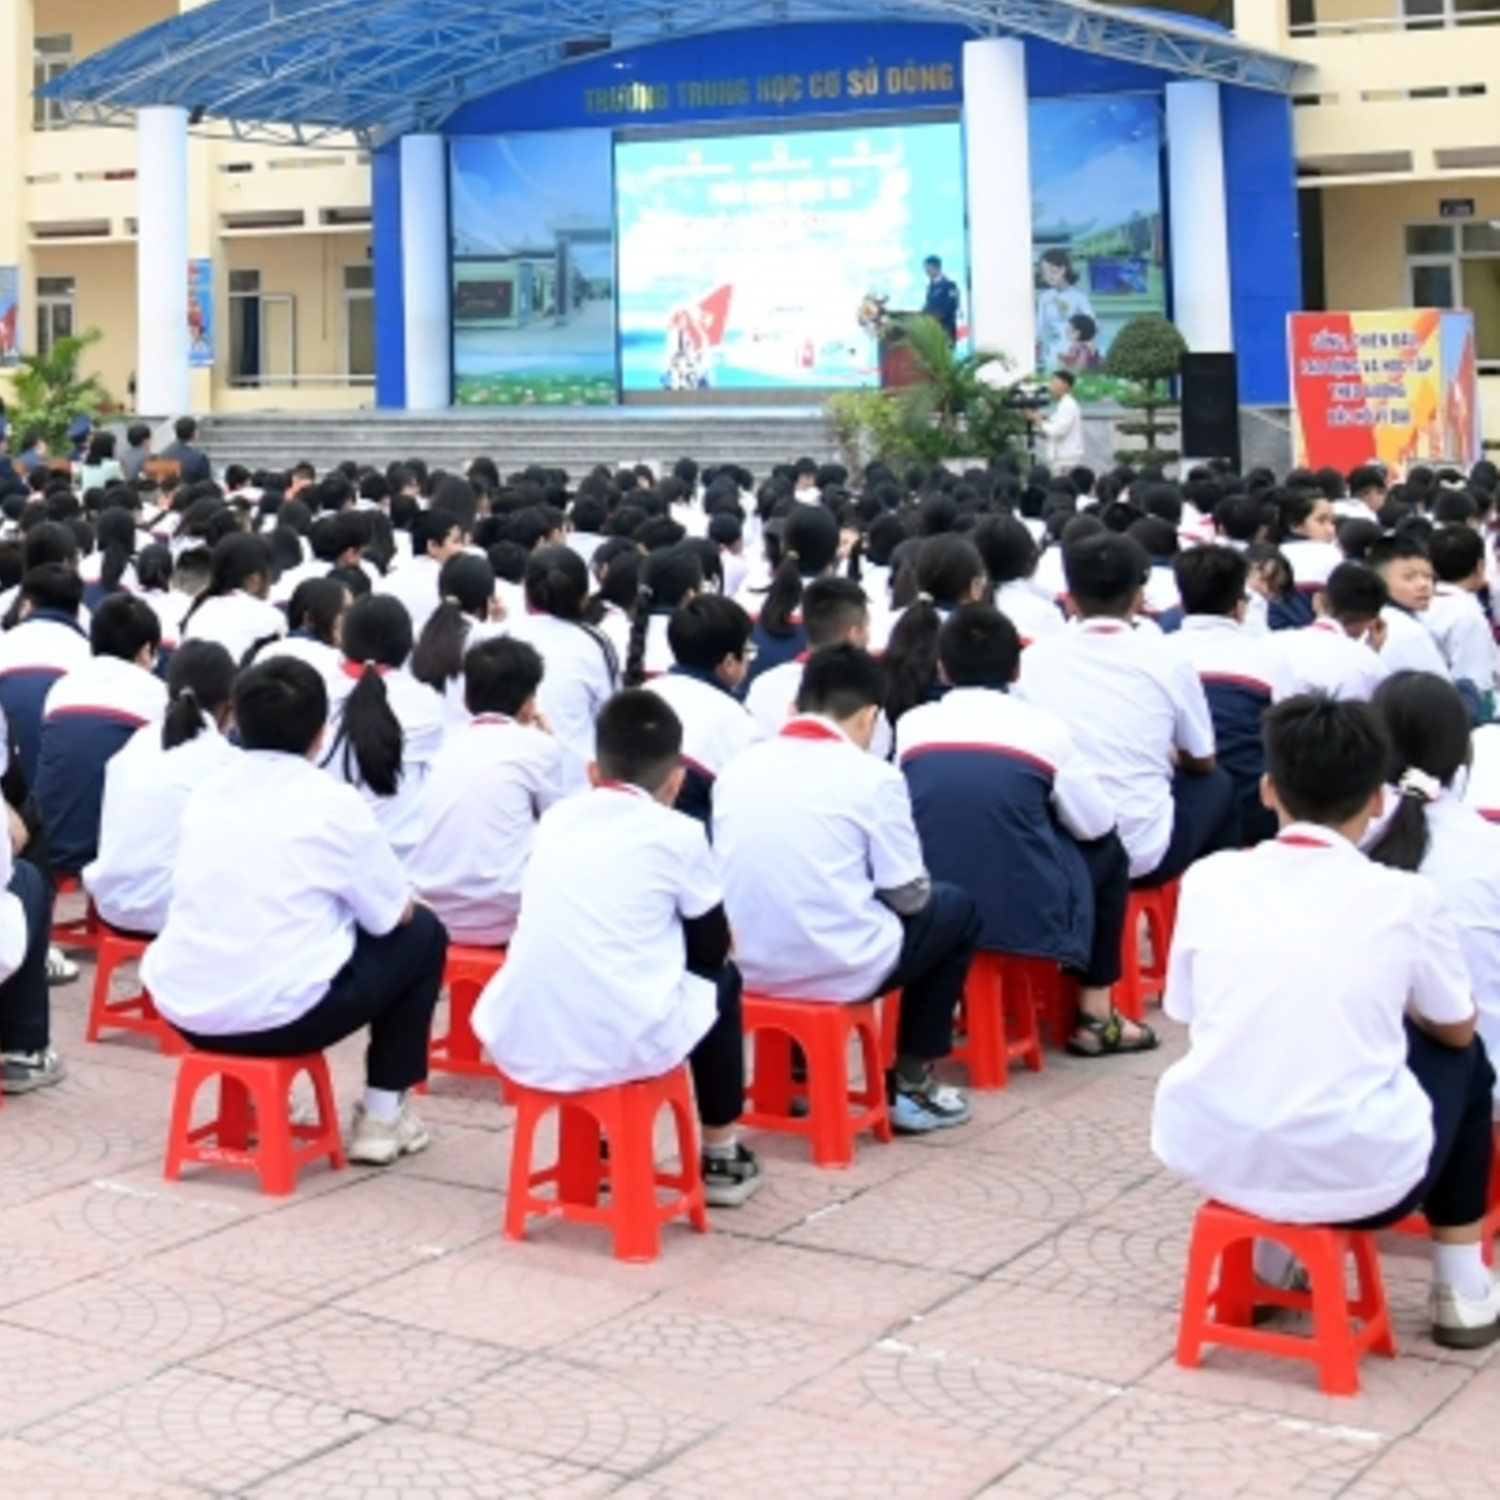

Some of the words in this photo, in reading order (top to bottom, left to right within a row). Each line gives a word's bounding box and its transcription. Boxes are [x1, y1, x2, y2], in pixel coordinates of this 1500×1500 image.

[585, 80, 668, 114] TRƯỜNG
[677, 81, 751, 108] TRUNG
[758, 75, 803, 106] HỌC
[810, 66, 842, 99] CƠ
[848, 58, 880, 97] SỞ
[887, 60, 954, 95] ĐÔNG
